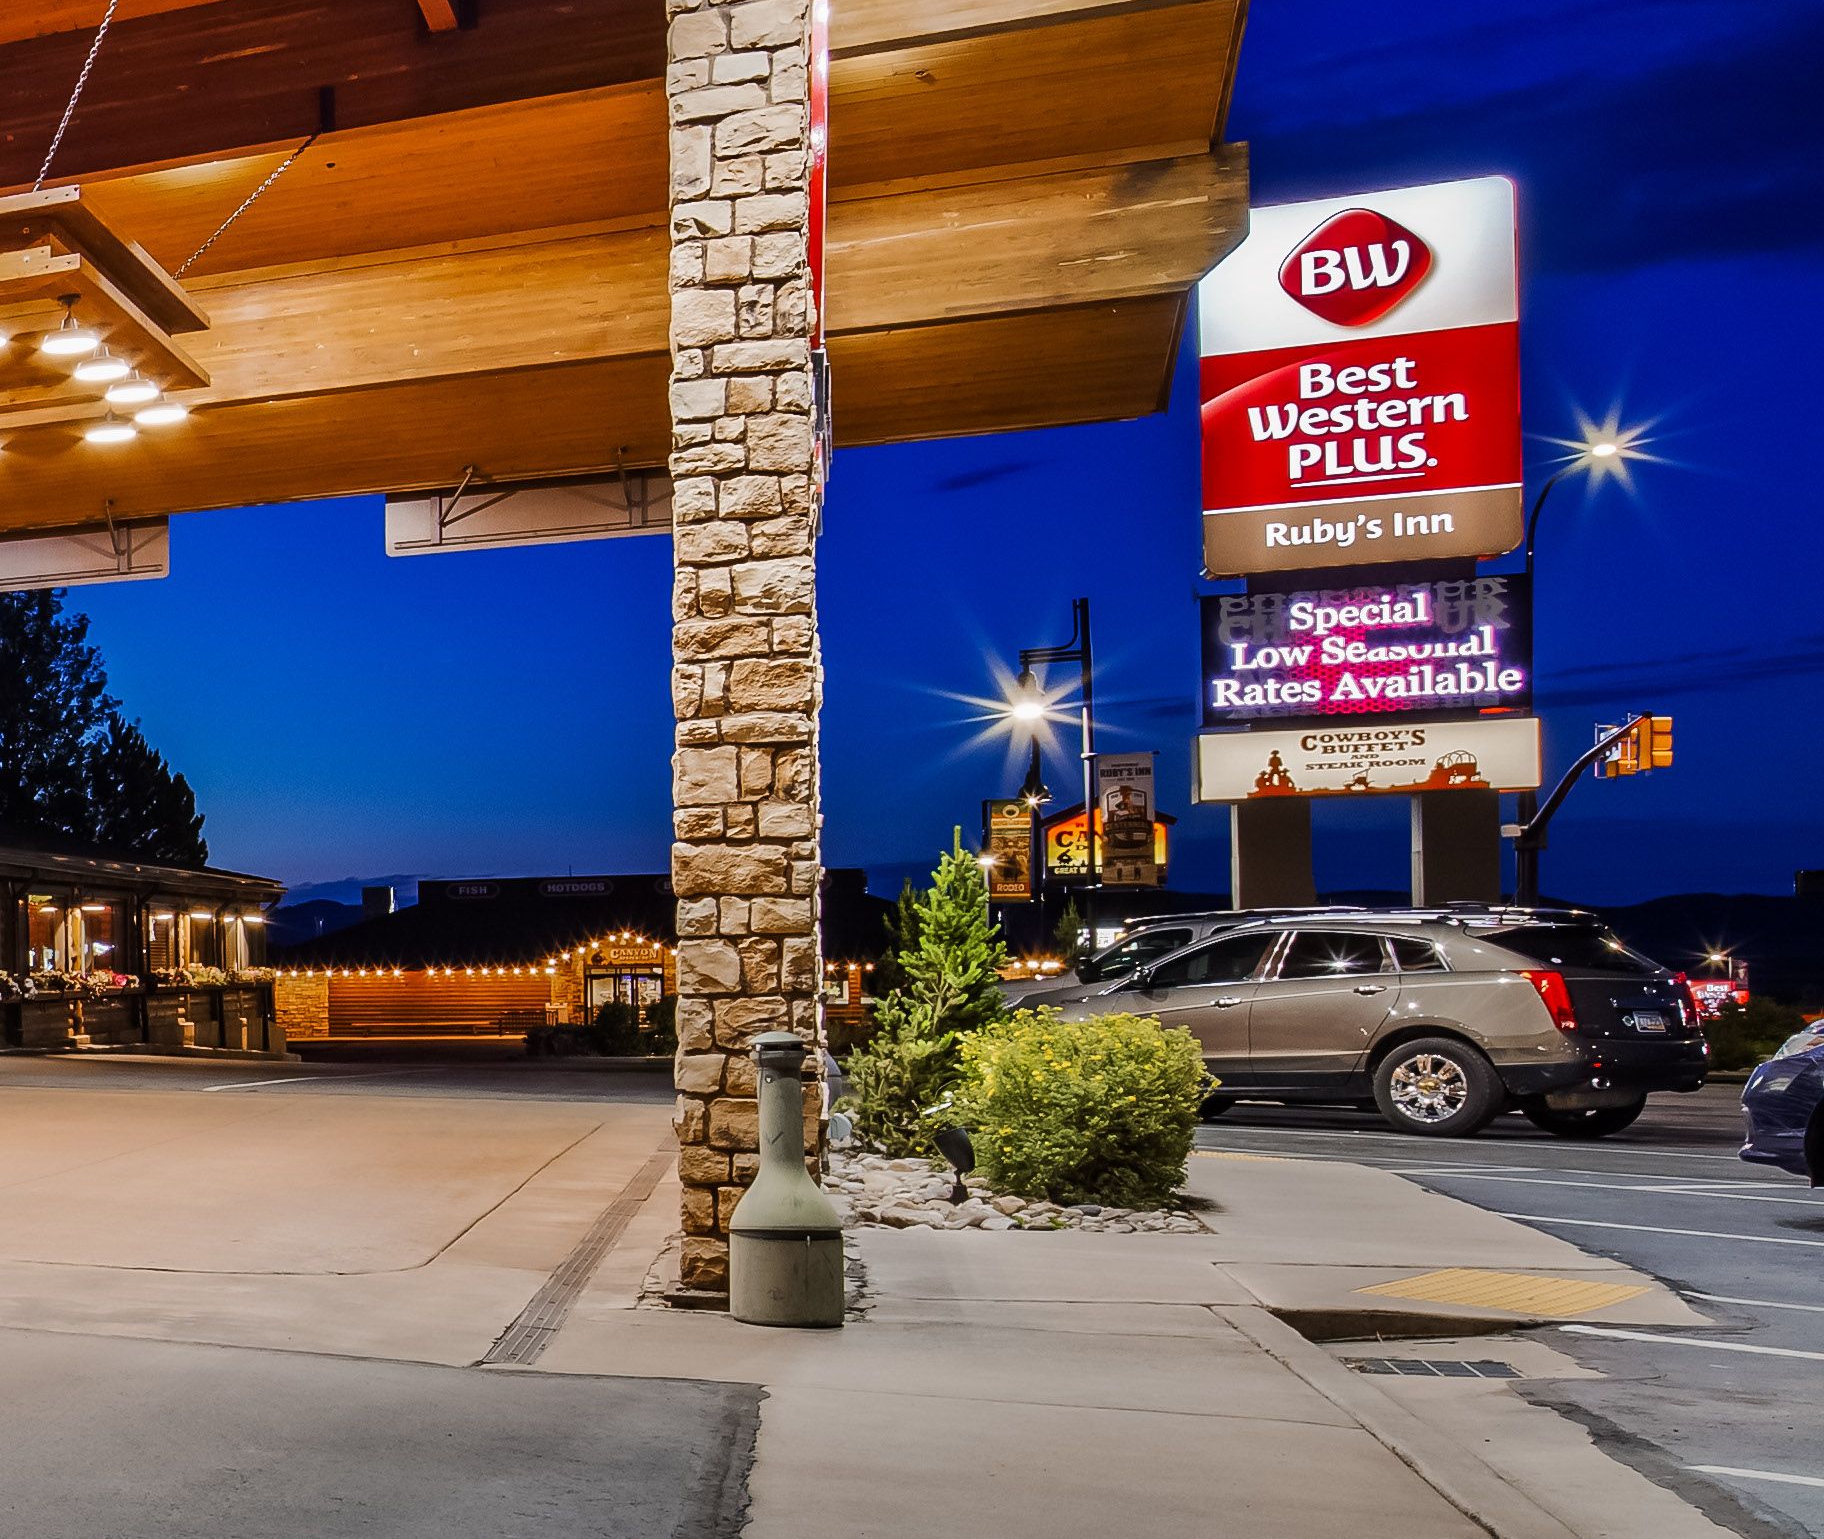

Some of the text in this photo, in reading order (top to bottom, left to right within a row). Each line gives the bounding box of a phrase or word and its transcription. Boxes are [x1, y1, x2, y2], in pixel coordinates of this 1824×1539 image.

[1301, 240, 1410, 296] BW
[1299, 357, 1417, 399] Best
[1247, 393, 1469, 442] Western
[1265, 512, 1455, 547] Ruby's Inn
[1289, 592, 1430, 635] Special
[1230, 642, 1314, 670] Low
[1212, 661, 1523, 707] Rates Available
[1300, 729, 1426, 752] COWBOY'S
[1321, 741, 1408, 755] BUFFET
[1099, 766, 1152, 778] RUBY'S INN
[1305, 758, 1427, 771] STEAK ROOM
[459, 886, 487, 894] FISH
[547, 882, 605, 893] HOTDOGS
[996, 883, 1025, 892] RODEO
[609, 948, 658, 959] CANYON
